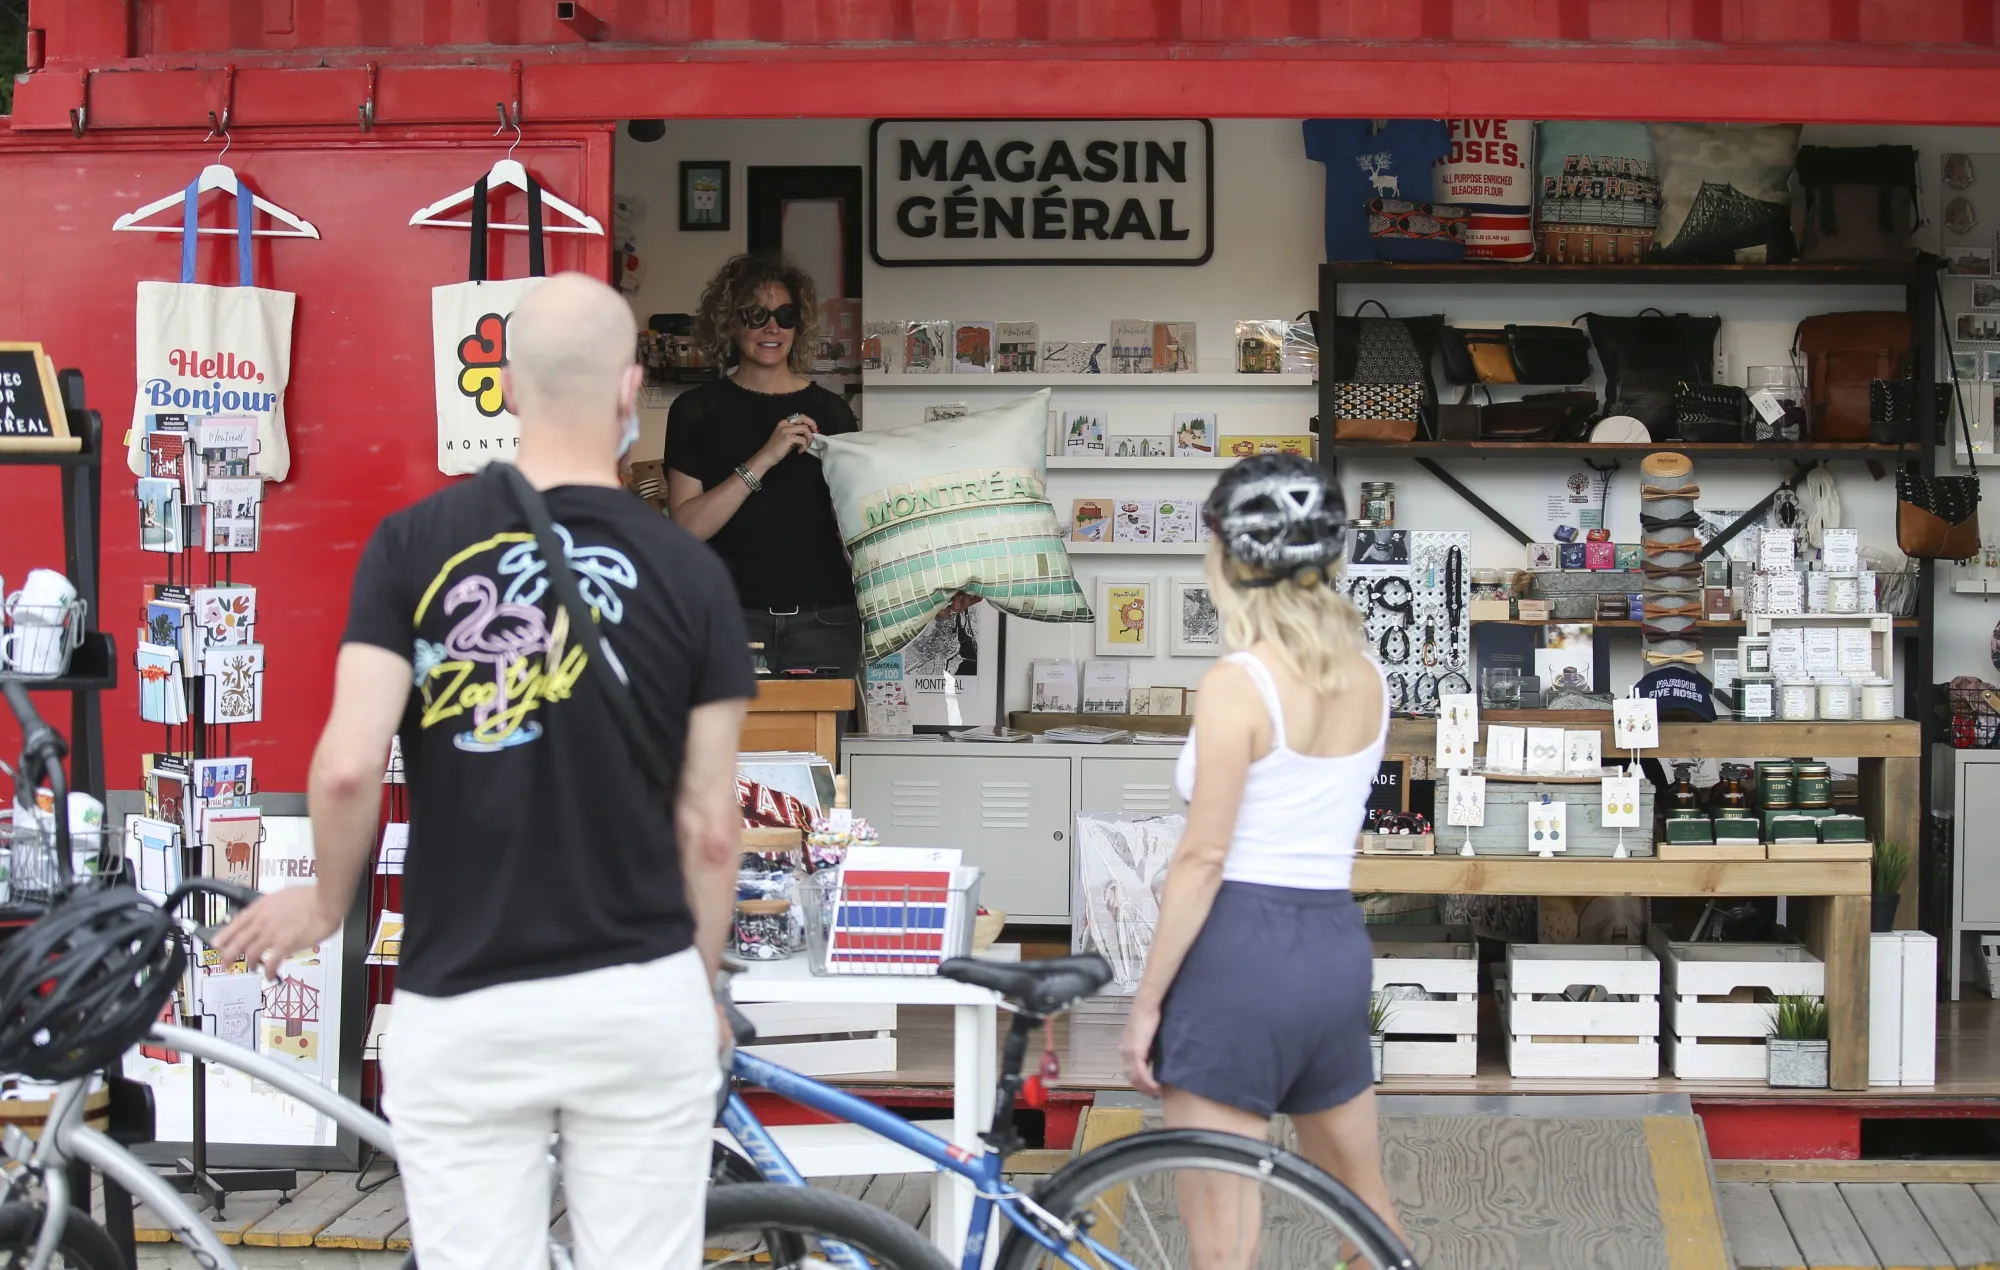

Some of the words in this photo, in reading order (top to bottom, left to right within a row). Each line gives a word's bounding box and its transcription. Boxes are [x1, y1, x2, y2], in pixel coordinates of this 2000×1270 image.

[1450, 119, 1508, 141] FIVE
[898, 139, 1187, 184] MAGASIN
[1432, 140, 1525, 170] OSES.
[1564, 153, 1650, 178] FARIN
[1442, 174, 1453, 184] ALL
[1454, 174, 1482, 184] PURPOSE
[1483, 175, 1513, 185] ENRICHED
[1544, 175, 1594, 195] FIVE
[1606, 176, 1662, 199] ROS
[1451, 186, 1483, 196] BLEACHED
[1484, 187, 1504, 197] FLOUR
[896, 184, 1190, 241] GÉNÉRAL
[169, 348, 265, 384] Hello,
[866, 471, 1045, 529] MONTRÉAL
[885, 669, 899, 679] 100
[915, 678, 965, 690] MONTRAL
[1656, 678, 1697, 692] FARINE
[1649, 688, 1670, 699] FIVE
[1673, 688, 1703, 703] ROSES
[1369, 774, 1396, 785] ADE
